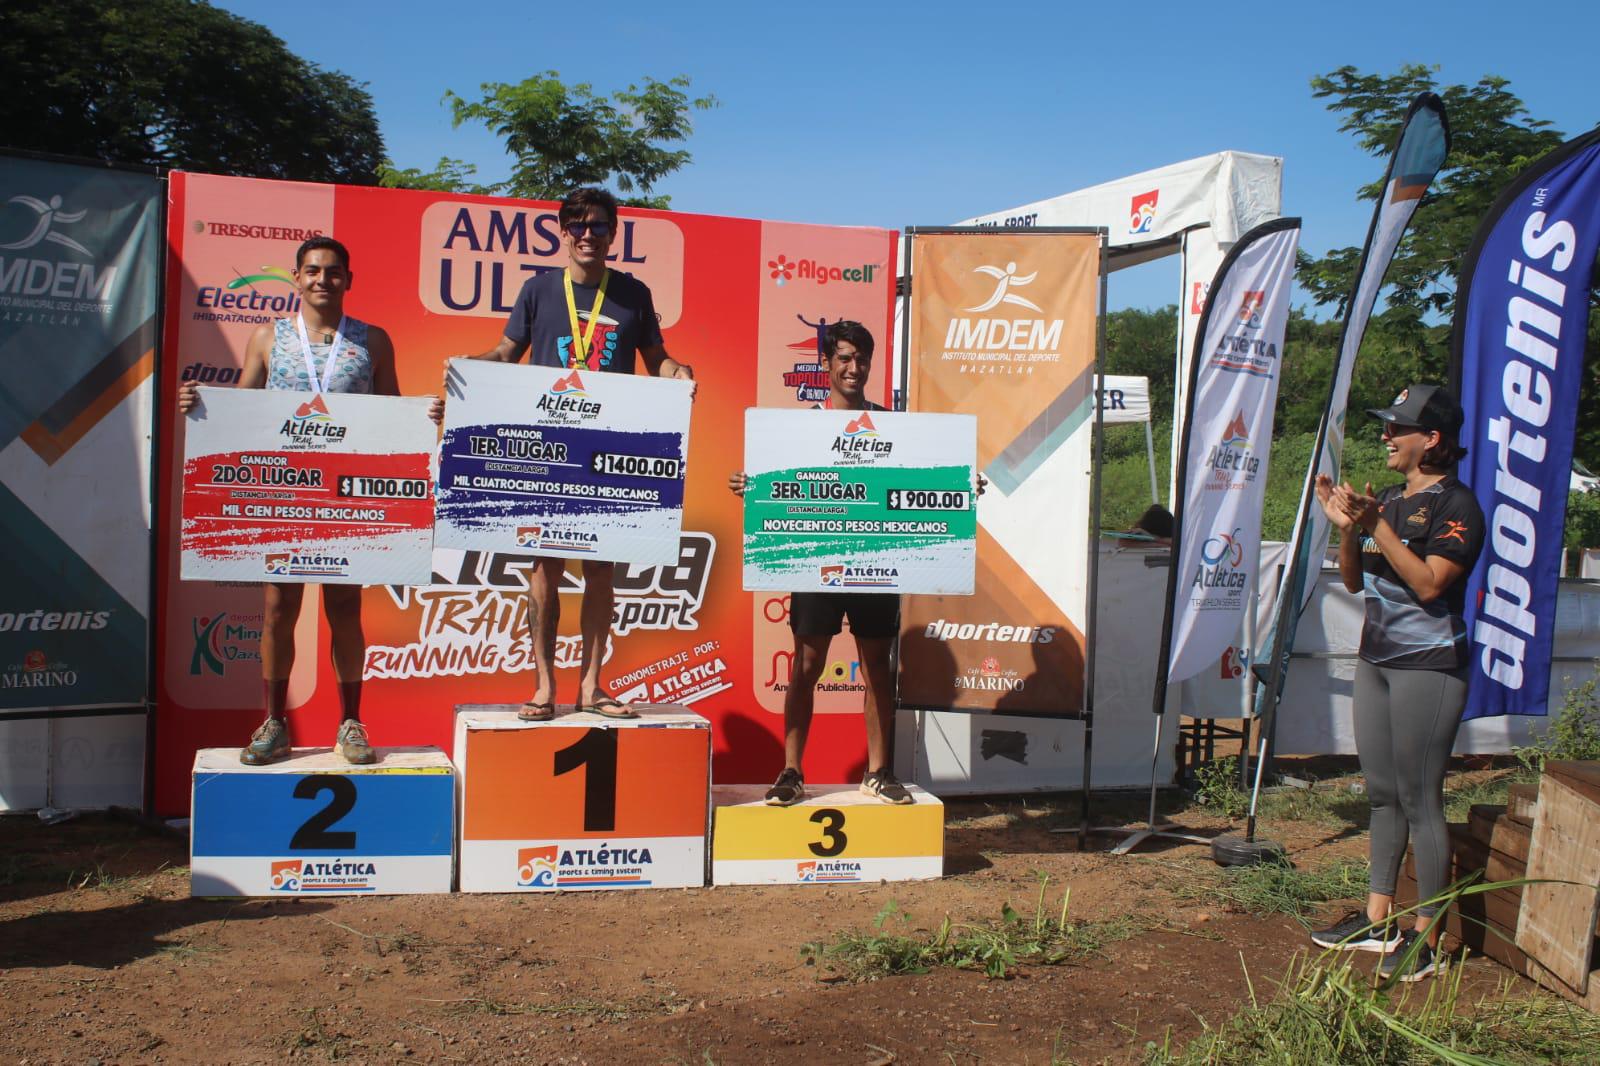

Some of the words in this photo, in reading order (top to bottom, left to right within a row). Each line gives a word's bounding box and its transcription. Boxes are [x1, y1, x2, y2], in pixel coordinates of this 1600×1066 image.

[443, 208, 646, 263] AMSL
[0, 257, 118, 300] MDEM
[798, 259, 873, 284] Algacell
[73, 302, 113, 313] DEPORTE
[196, 286, 302, 312] Electroli
[943, 318, 1064, 350] IMDEM
[941, 352, 977, 361] INSTITUTO
[977, 353, 1012, 361] MUNICIPAL
[1013, 353, 1027, 362] DEL
[1028, 353, 1061, 362] DEPORTE
[536, 394, 602, 415] Atlética
[280, 419, 347, 438] Atlética
[497, 428, 542, 440] GANADOR
[1475, 211, 1576, 690] dportenis
[1532, 187, 1548, 207] MR
[470, 436, 502, 457] 1ER.
[507, 440, 567, 462] LUGAR
[831, 436, 893, 453] Atlética
[240, 455, 287, 466] GANADOR
[594, 456, 603, 471] $
[607, 455, 676, 477] 1400.00
[212, 465, 257, 485] 2DO.
[261, 468, 322, 486] LUGAR
[795, 471, 839, 481] GANADOR
[340, 478, 350, 495] $
[359, 479, 426, 497] 1100.00
[453, 475, 470, 486] MIL
[473, 476, 561, 494] CUATROCIENTOS
[562, 483, 595, 496] PESOS
[597, 486, 659, 501] MEXICANOS
[771, 482, 805, 500] 3ER.
[810, 482, 866, 500] LUGAR
[890, 492, 899, 508] $
[906, 491, 964, 509] 900.00
[222, 504, 242, 516] MIL
[244, 505, 272, 517] CIEN
[275, 507, 312, 519] PESOS
[315, 508, 385, 521] MEXICANOS
[763, 519, 843, 533] NOVECIENTOS
[845, 520, 880, 533] PESOS
[882, 521, 947, 534] MEXICANOS
[0, 609, 111, 632] ortenis
[421, 591, 531, 637] TRAIL
[924, 618, 1056, 644] dportenis
[365, 646, 499, 674] RUNNING
[609, 651, 689, 691] CRONOMETRAJE
[693, 640, 721, 657] POR:
[2, 671, 77, 688] MARINO
[817, 683, 866, 692] Publicitario
[962, 676, 1025, 692] MARINO
[554, 727, 618, 832] 1
[289, 774, 357, 850] 2
[807, 808, 848, 857] 3
[559, 868, 582, 876] sports
[591, 867, 614, 876] timing
[616, 867, 642, 875] system
